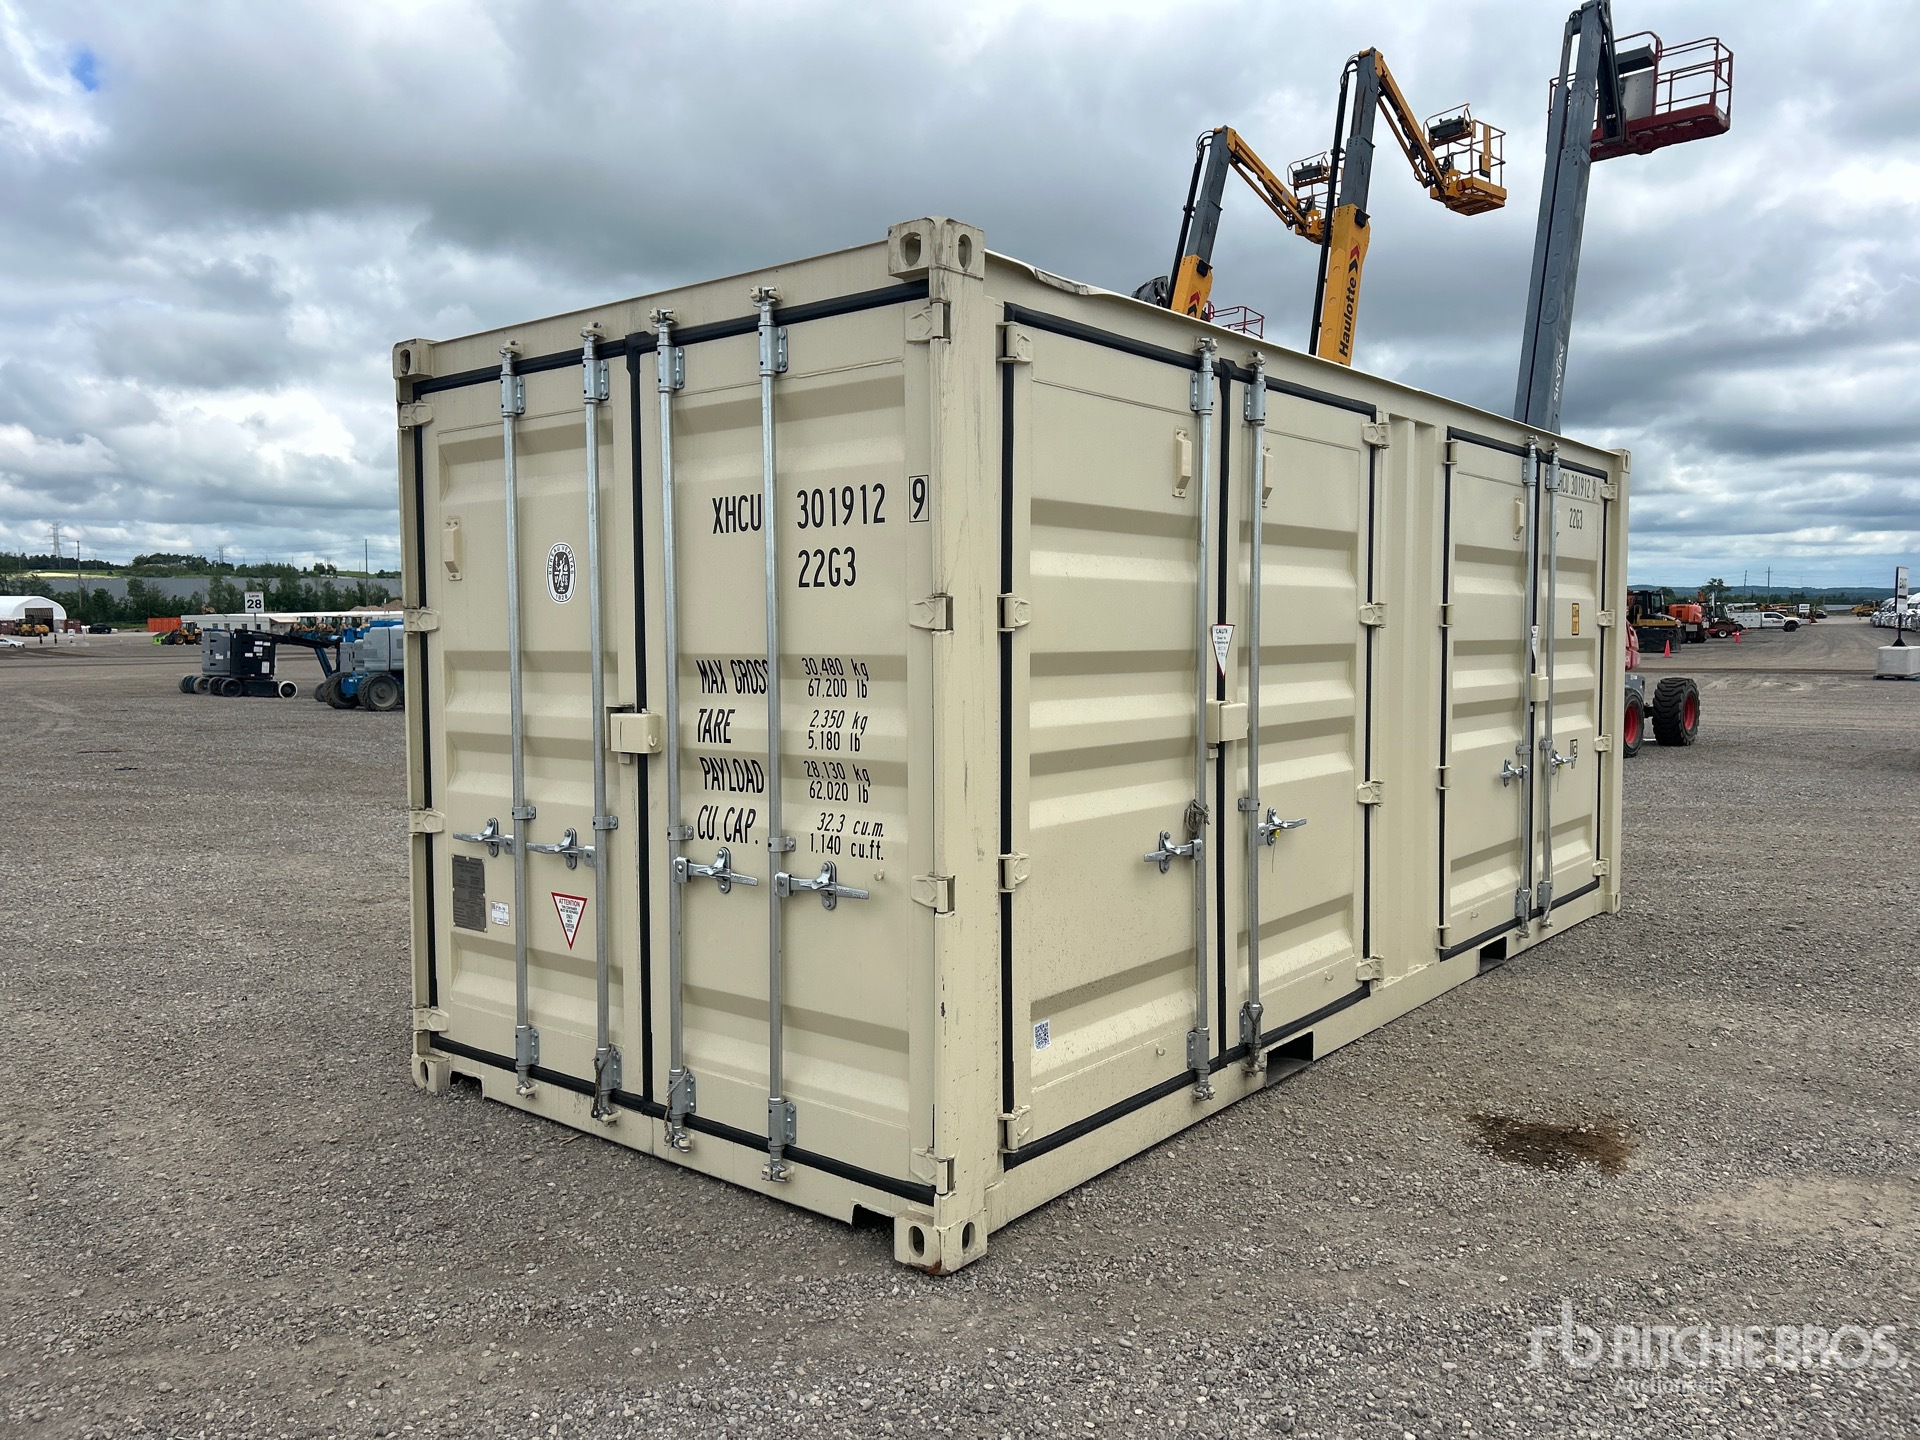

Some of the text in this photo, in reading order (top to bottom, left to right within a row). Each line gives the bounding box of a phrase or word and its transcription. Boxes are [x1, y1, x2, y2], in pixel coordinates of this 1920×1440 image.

[1339, 276, 1357, 357] Haulotte
[1558, 472, 1570, 494] HCU
[1571, 474, 1591, 498] 301912
[712, 478, 926, 534] XHCU 301912 9
[1569, 508, 1583, 530] 22G3
[798, 546, 856, 588] 22G3
[247, 599, 262, 609] 28
[696, 659, 727, 694] MAX
[801, 657, 869, 682] 30,480 kg
[808, 678, 868, 699] 67,200 lb
[697, 708, 736, 744] TARE
[809, 709, 868, 735] 2,350 kg
[808, 730, 861, 752] 5,180 lb
[699, 756, 764, 793] PAYLOAD
[852, 764, 871, 787] kg
[809, 780, 869, 804] 62,020 lb
[816, 812, 846, 833] 32.3
[810, 832, 841, 856] 1,140
